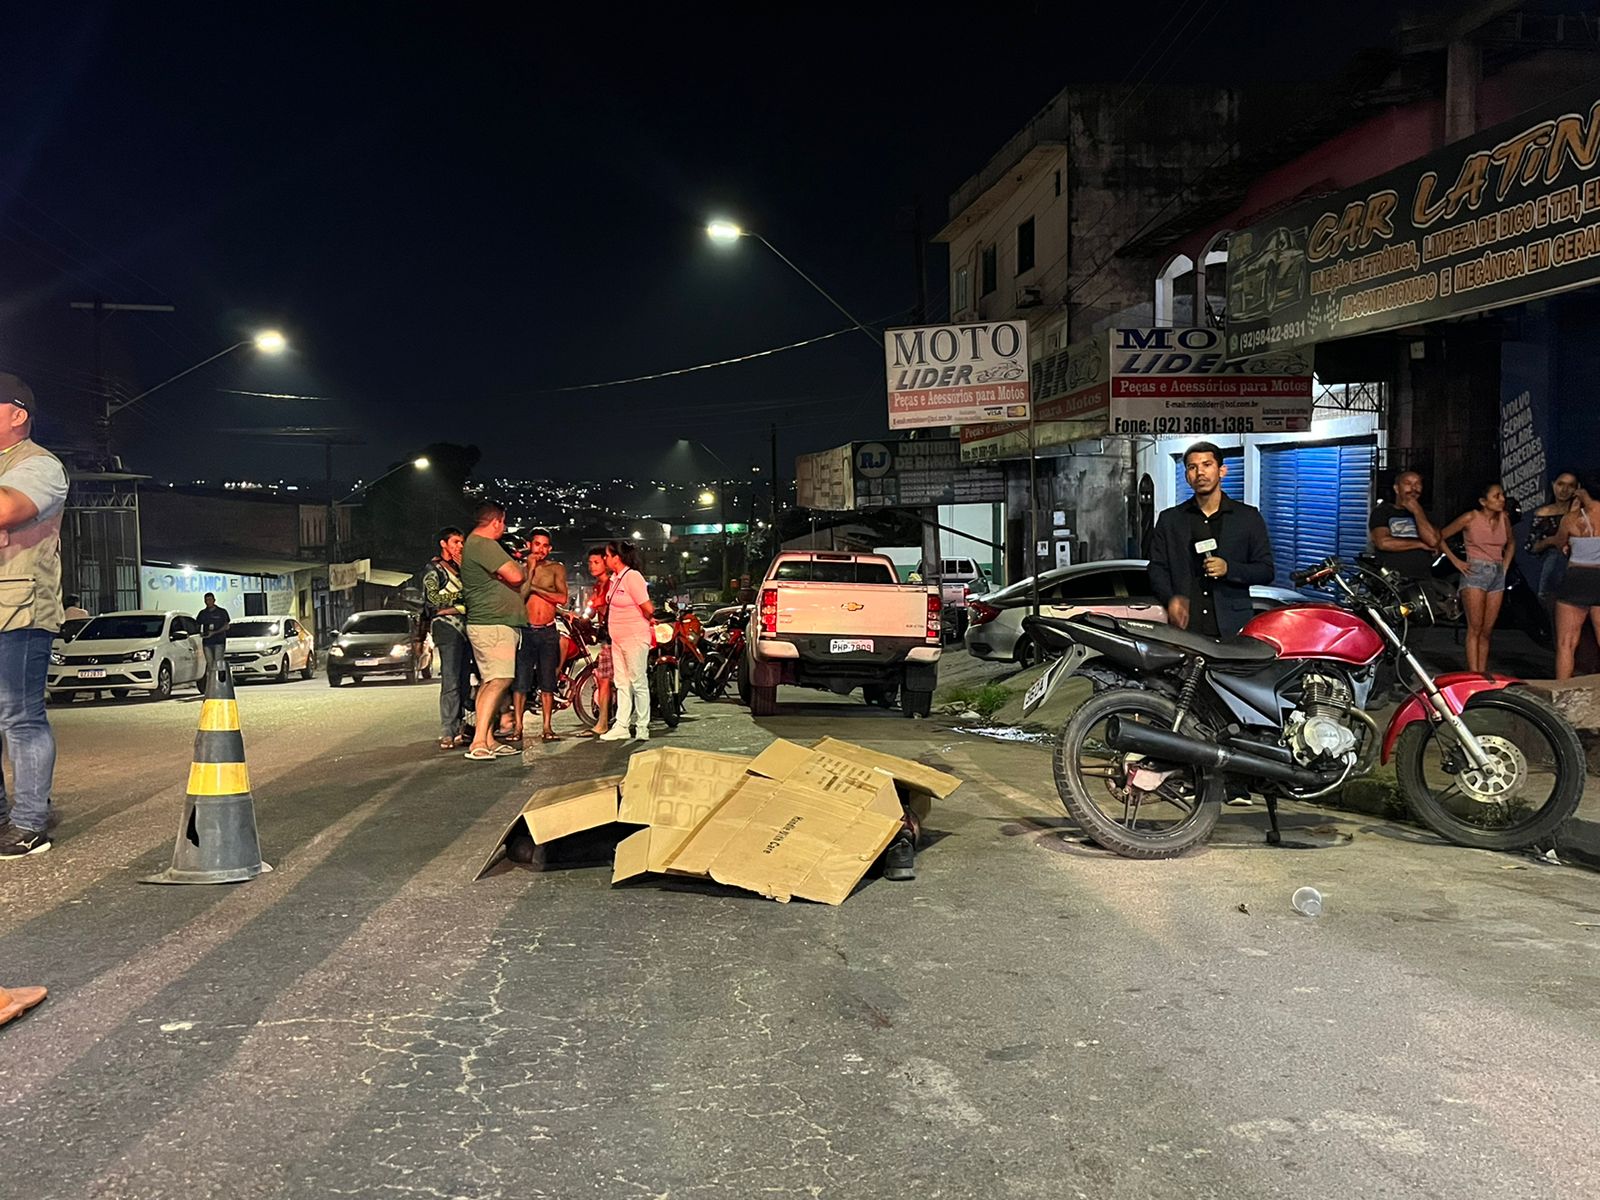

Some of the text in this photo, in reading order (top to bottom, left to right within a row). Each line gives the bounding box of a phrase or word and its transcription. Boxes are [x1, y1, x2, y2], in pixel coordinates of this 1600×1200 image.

[1306, 189, 1399, 262] CAR
[1422, 220, 1476, 263] LIMPEZA
[1477, 211, 1499, 247] DE
[1498, 200, 1535, 241] BICO
[1535, 195, 1549, 229] E
[1548, 184, 1581, 223] TBI,
[1440, 267, 1452, 297] E
[1453, 250, 1527, 294] MECÂNICA
[1526, 237, 1551, 274] EM
[893, 323, 1021, 368] MOTO
[1115, 328, 1218, 350] MO
[1240, 320, 1305, 353] (92)98422-8931
[896, 365, 973, 390] LIDER
[1120, 379, 1309, 395] Peças e Acessórios para Motos
[894, 386, 1025, 411] Peças e Acessórios para Motos
[1502, 391, 1531, 420] VOLVO
[1114, 416, 1254, 433] Fone: (92) 3681-1385
[859, 452, 887, 468] RJ
[1501, 437, 1542, 473] MERCEDES
[230, 578, 238, 588] E
[763, 840, 780, 854] Care
